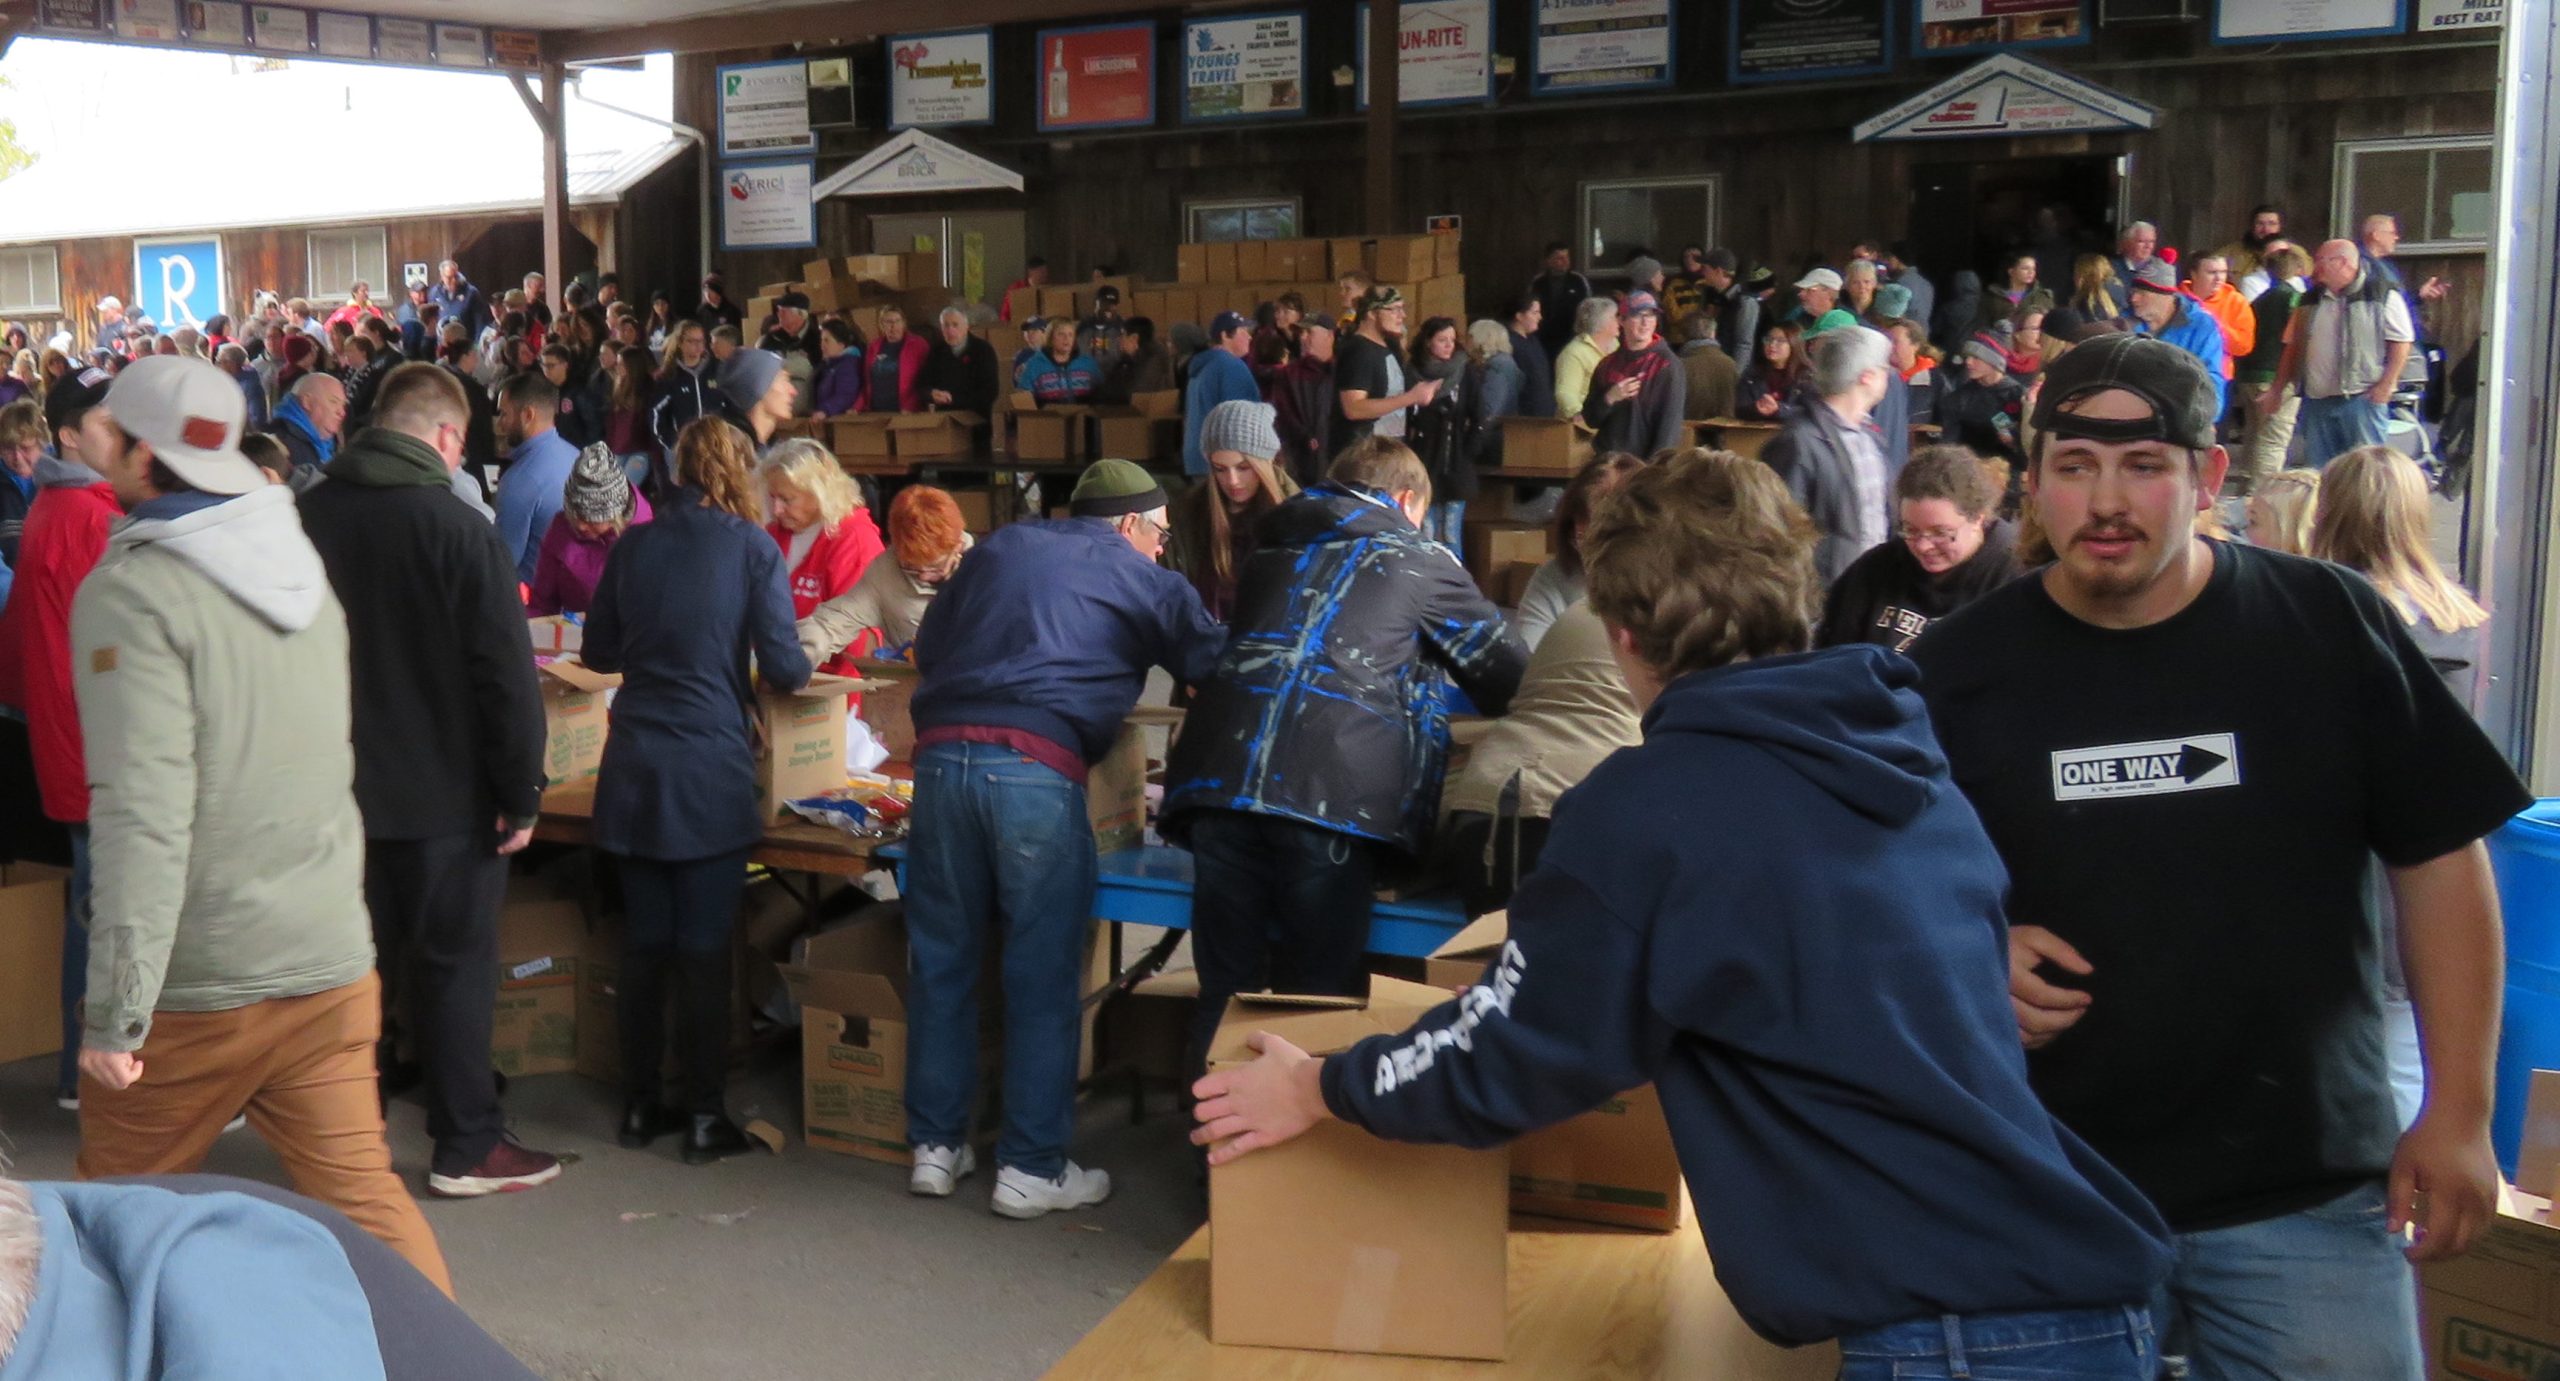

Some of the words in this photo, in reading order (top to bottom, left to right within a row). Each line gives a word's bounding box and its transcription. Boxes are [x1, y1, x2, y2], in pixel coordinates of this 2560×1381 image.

[1256, 22, 1272, 31] CALL
[2433, 13, 2468, 26] BEST
[2474, 11, 2502, 23] RAT
[1255, 32, 1267, 40] ALL
[1270, 30, 1290, 38] YOUR
[1398, 26, 1464, 50] UN-RITE
[909, 57, 982, 79] Transmission
[1188, 52, 1240, 69] YOUNGS
[951, 76, 987, 89] Service
[1192, 68, 1236, 84] TRAVEL
[160, 253, 205, 334] R
[2062, 760, 2118, 785] ONE
[2122, 753, 2183, 781] WAY
[832, 1047, 880, 1067] U-HAUL
